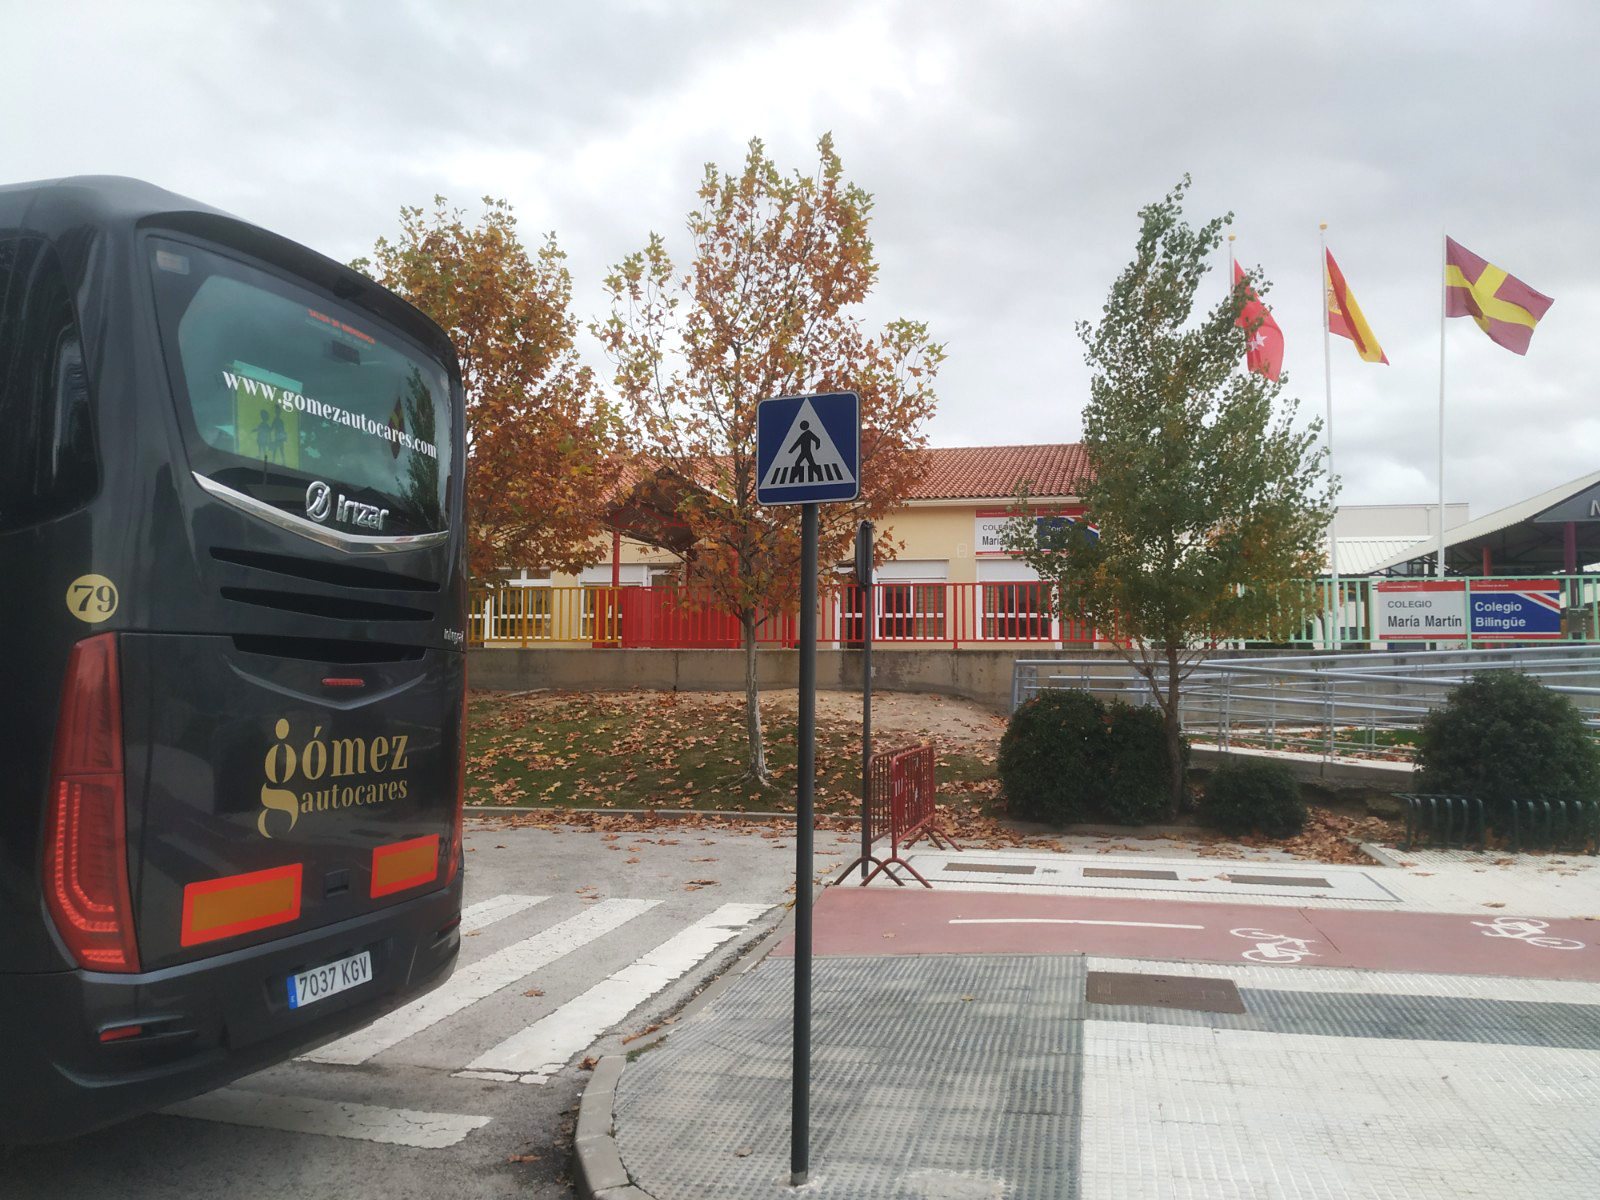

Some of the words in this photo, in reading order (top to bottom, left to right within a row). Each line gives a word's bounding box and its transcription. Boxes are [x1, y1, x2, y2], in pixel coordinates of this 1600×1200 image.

[222, 371, 438, 459] www.gomezautocares.com
[336, 493, 390, 531] Irizar
[73, 585, 116, 613] 79
[1387, 600, 1432, 609] COLEGIO
[1474, 601, 1522, 614] Colegio
[1387, 614, 1420, 628] María
[1425, 614, 1463, 628] Martín
[1475, 616, 1526, 630] Bilingüe
[257, 718, 409, 839] gómez
[300, 779, 408, 813] autocares
[299, 966, 336, 1001] 7037
[341, 956, 367, 986] KGV
